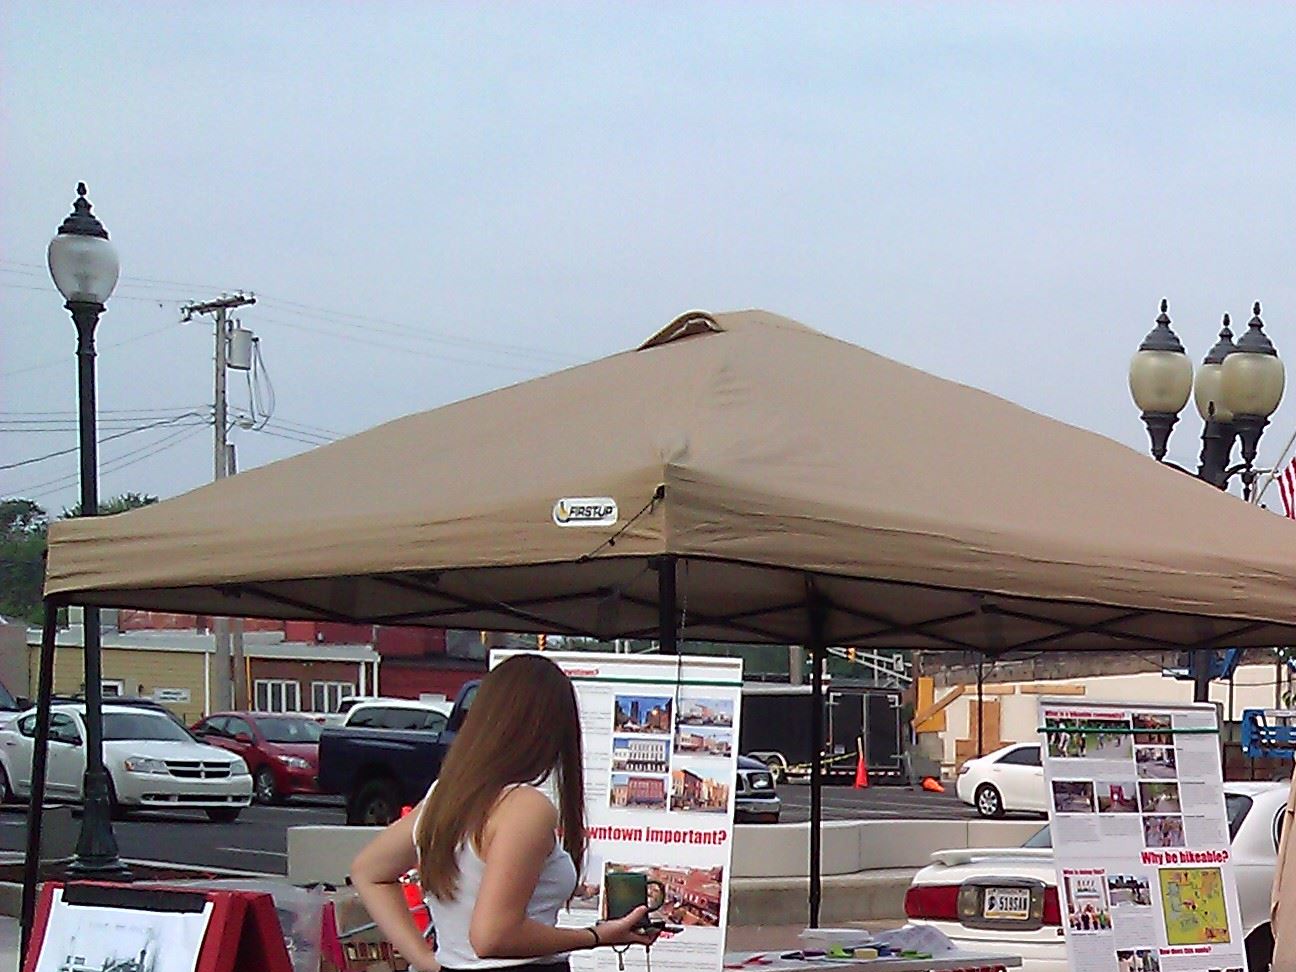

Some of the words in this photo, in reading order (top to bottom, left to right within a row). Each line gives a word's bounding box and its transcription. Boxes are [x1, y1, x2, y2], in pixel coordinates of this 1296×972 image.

[588, 826, 642, 841] wntown
[646, 826, 727, 846] important?
[1141, 851, 1164, 866] Why
[1165, 850, 1178, 864] be
[1180, 849, 1229, 864] bikeable?
